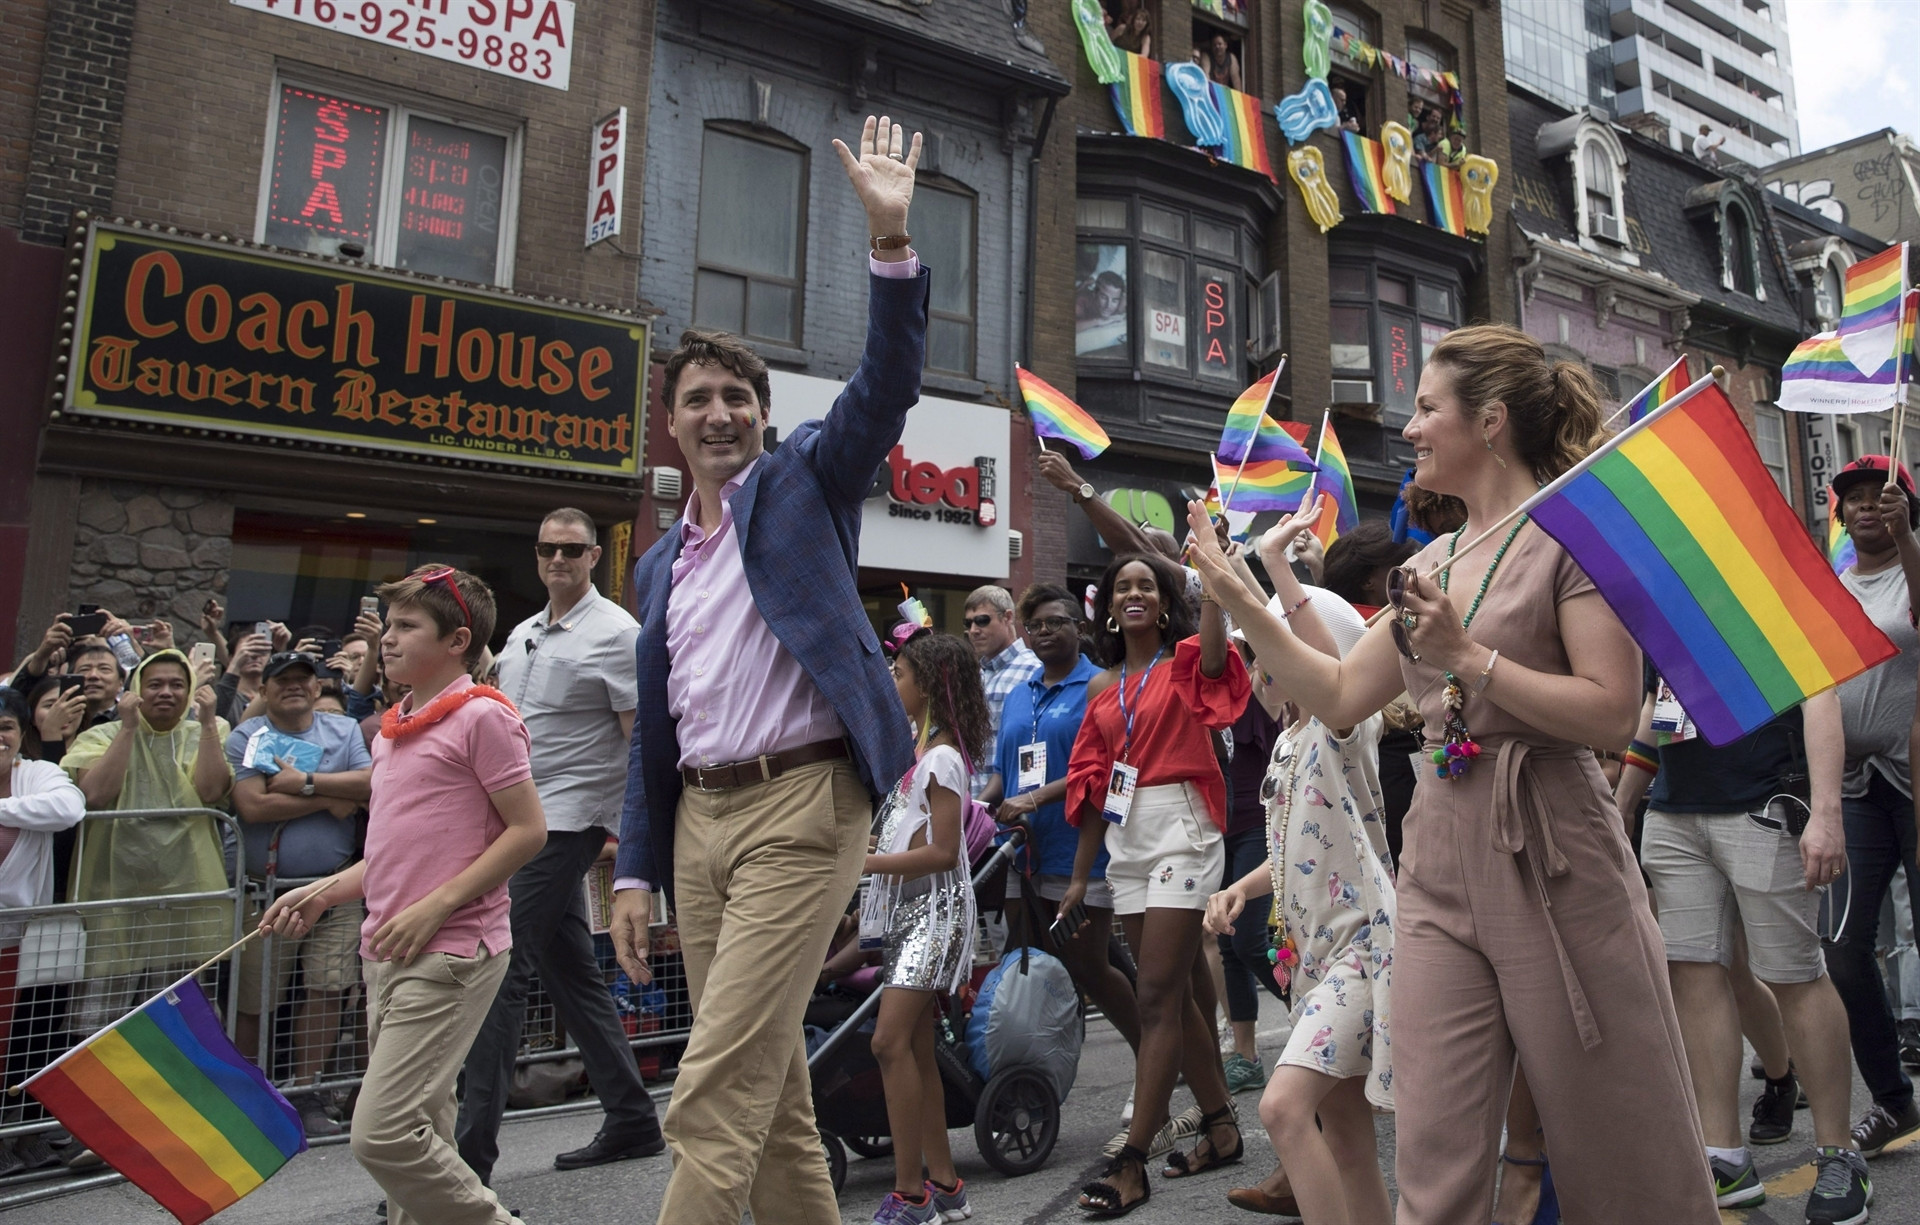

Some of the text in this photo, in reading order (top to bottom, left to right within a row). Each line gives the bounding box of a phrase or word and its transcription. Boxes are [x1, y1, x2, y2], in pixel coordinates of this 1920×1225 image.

[266, 0, 552, 80] 16-925-9883
[468, 0, 565, 48] SPA
[301, 103, 350, 223] SPA
[478, 164, 501, 234] OPEN
[593, 118, 620, 224] SPA
[591, 216, 616, 241] 574
[125, 250, 613, 401] Coach House
[1155, 312, 1180, 337] SPA
[1205, 283, 1227, 365] SPA
[89, 335, 632, 454] Tavern Restaurant
[429, 433, 460, 446] LIC.
[463, 438, 517, 452] UNDER
[888, 503, 931, 521] Since
[935, 508, 972, 525] 1992
